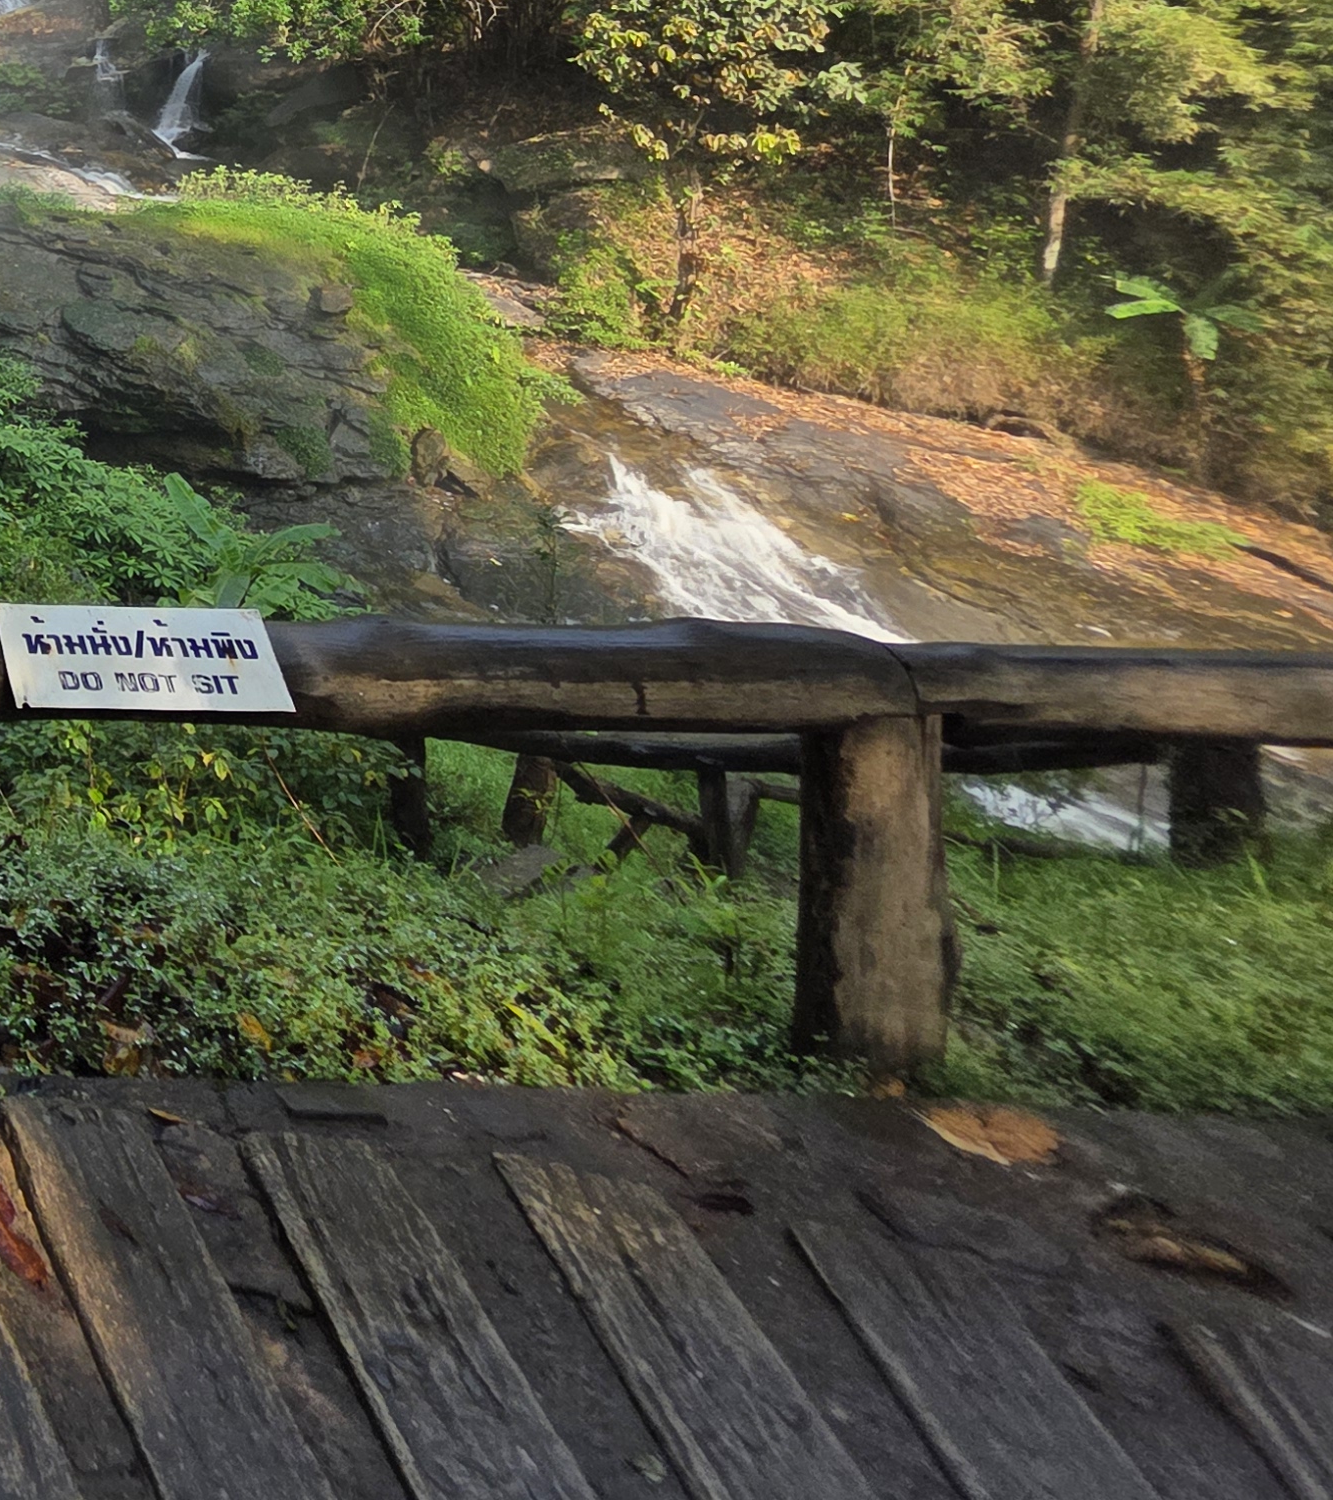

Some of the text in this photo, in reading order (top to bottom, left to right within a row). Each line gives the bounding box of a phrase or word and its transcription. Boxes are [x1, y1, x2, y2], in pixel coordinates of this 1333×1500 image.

[58, 670, 239, 695] DO NOT SIT
